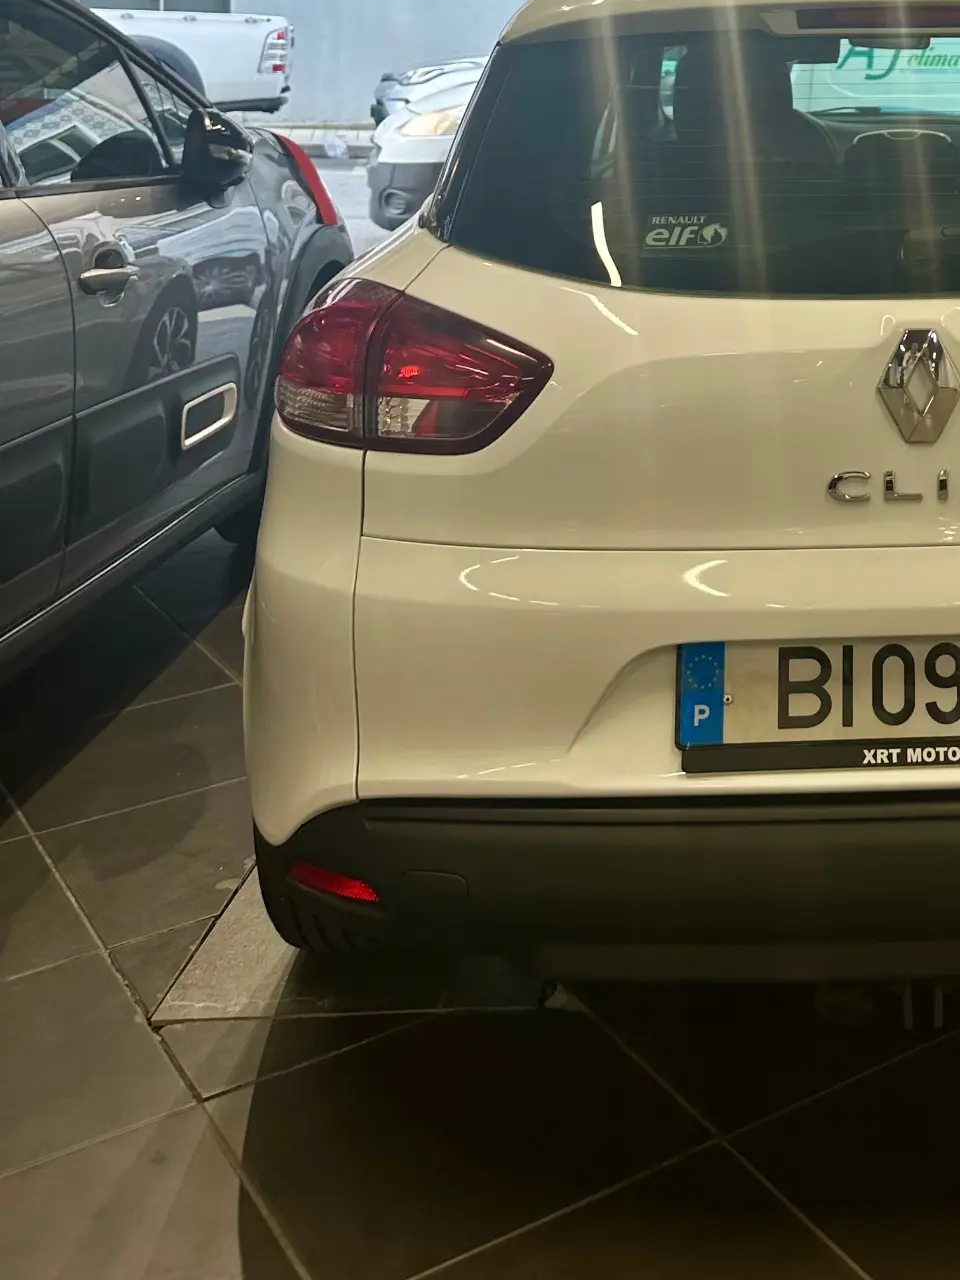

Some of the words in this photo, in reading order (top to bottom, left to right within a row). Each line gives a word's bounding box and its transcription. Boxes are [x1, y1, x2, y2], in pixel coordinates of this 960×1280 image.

[651, 216, 706, 225] RENAULT
[645, 226, 699, 246] elf
[694, 704, 710, 727] P
[863, 749, 900, 765] XRT
